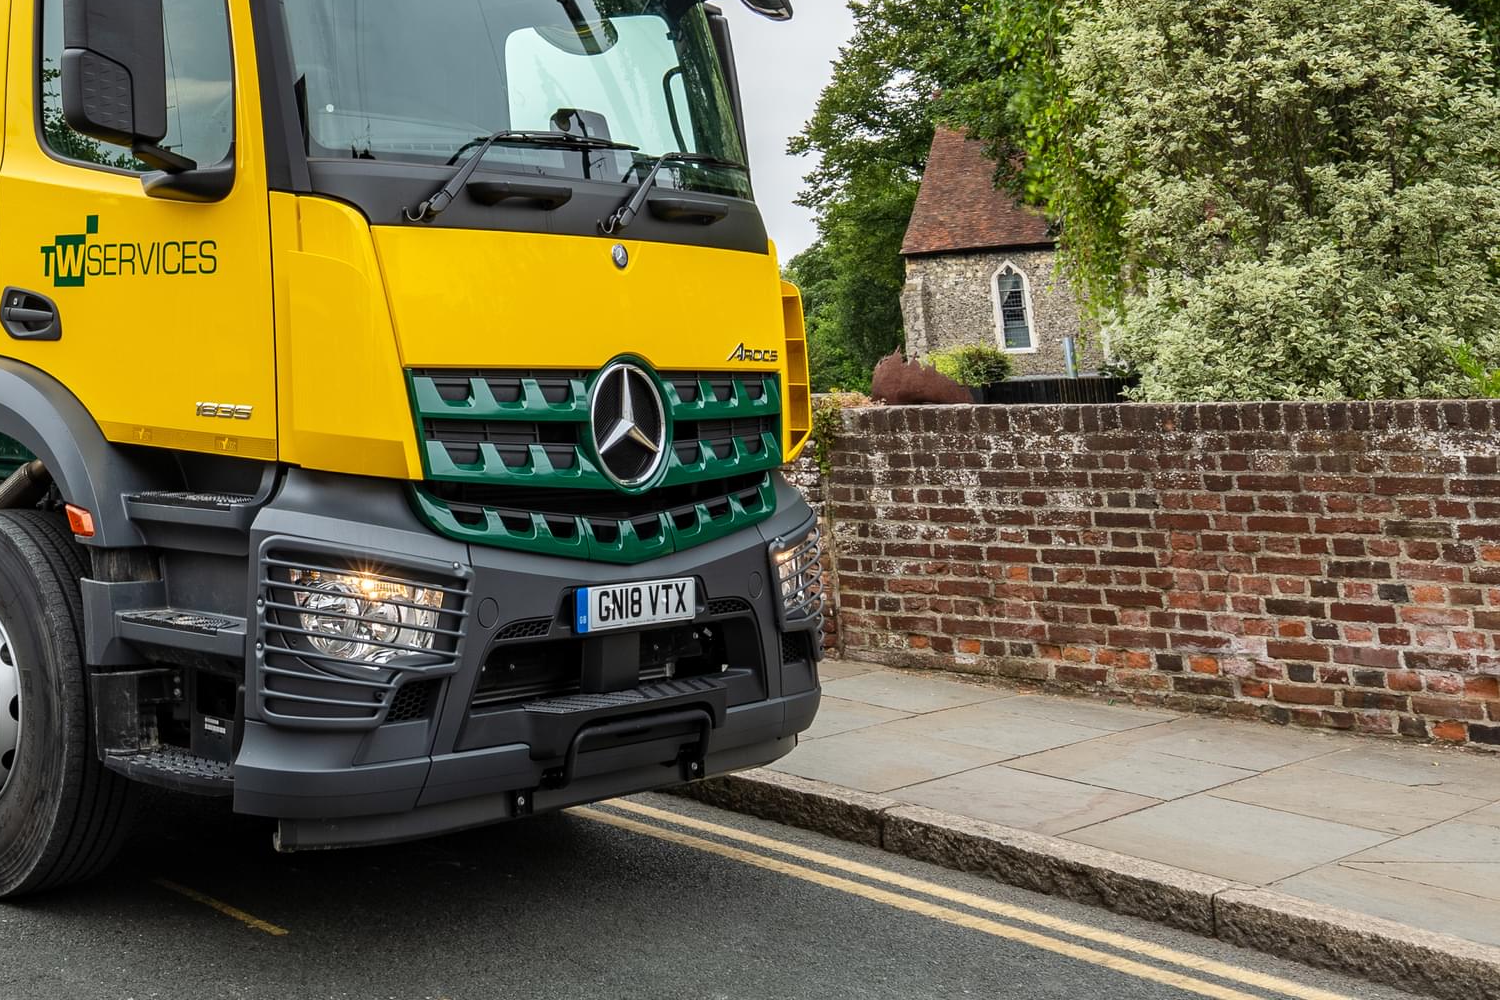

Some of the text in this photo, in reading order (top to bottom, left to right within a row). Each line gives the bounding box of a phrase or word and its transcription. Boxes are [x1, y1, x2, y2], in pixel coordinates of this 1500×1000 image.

[87, 240, 217, 276] SERVICES
[599, 582, 687, 622] GN18 VTX
